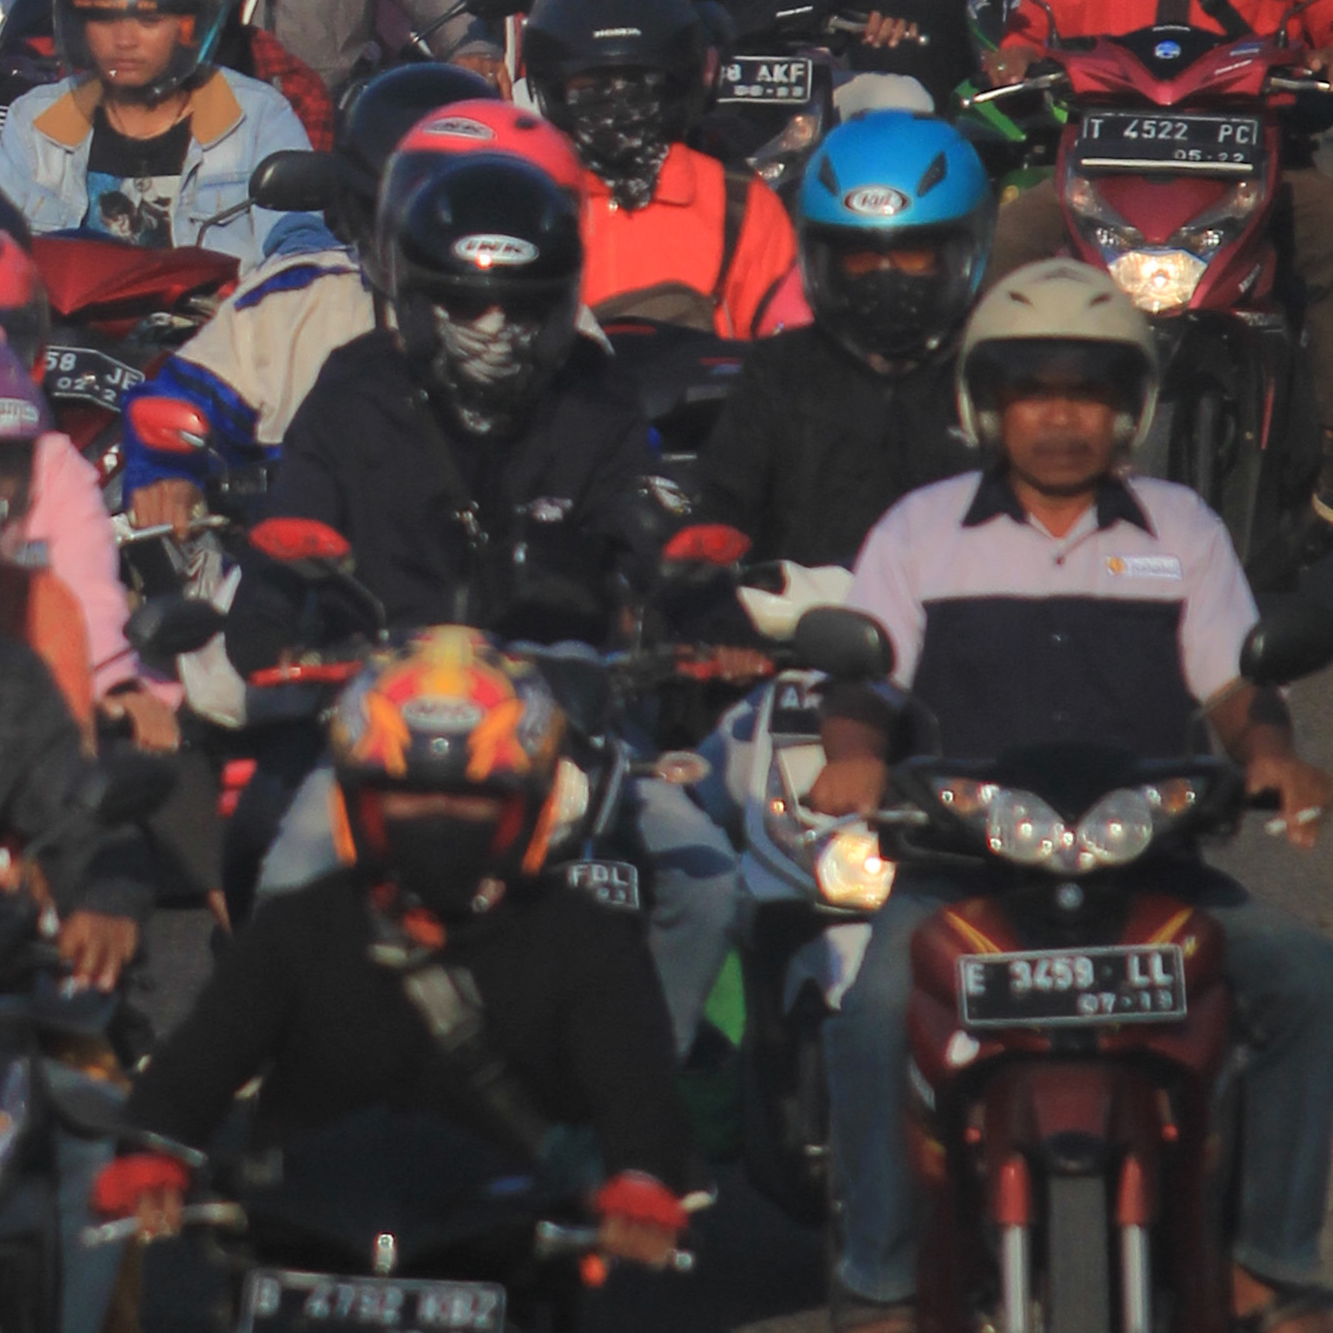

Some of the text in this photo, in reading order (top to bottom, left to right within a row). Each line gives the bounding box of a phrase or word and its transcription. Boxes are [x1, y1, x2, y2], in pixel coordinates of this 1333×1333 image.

[755, 63, 805, 84] AKF
[1089, 119, 1251, 145] T 4522 PC
[965, 964, 986, 995] E
[1127, 953, 1173, 987] LL
